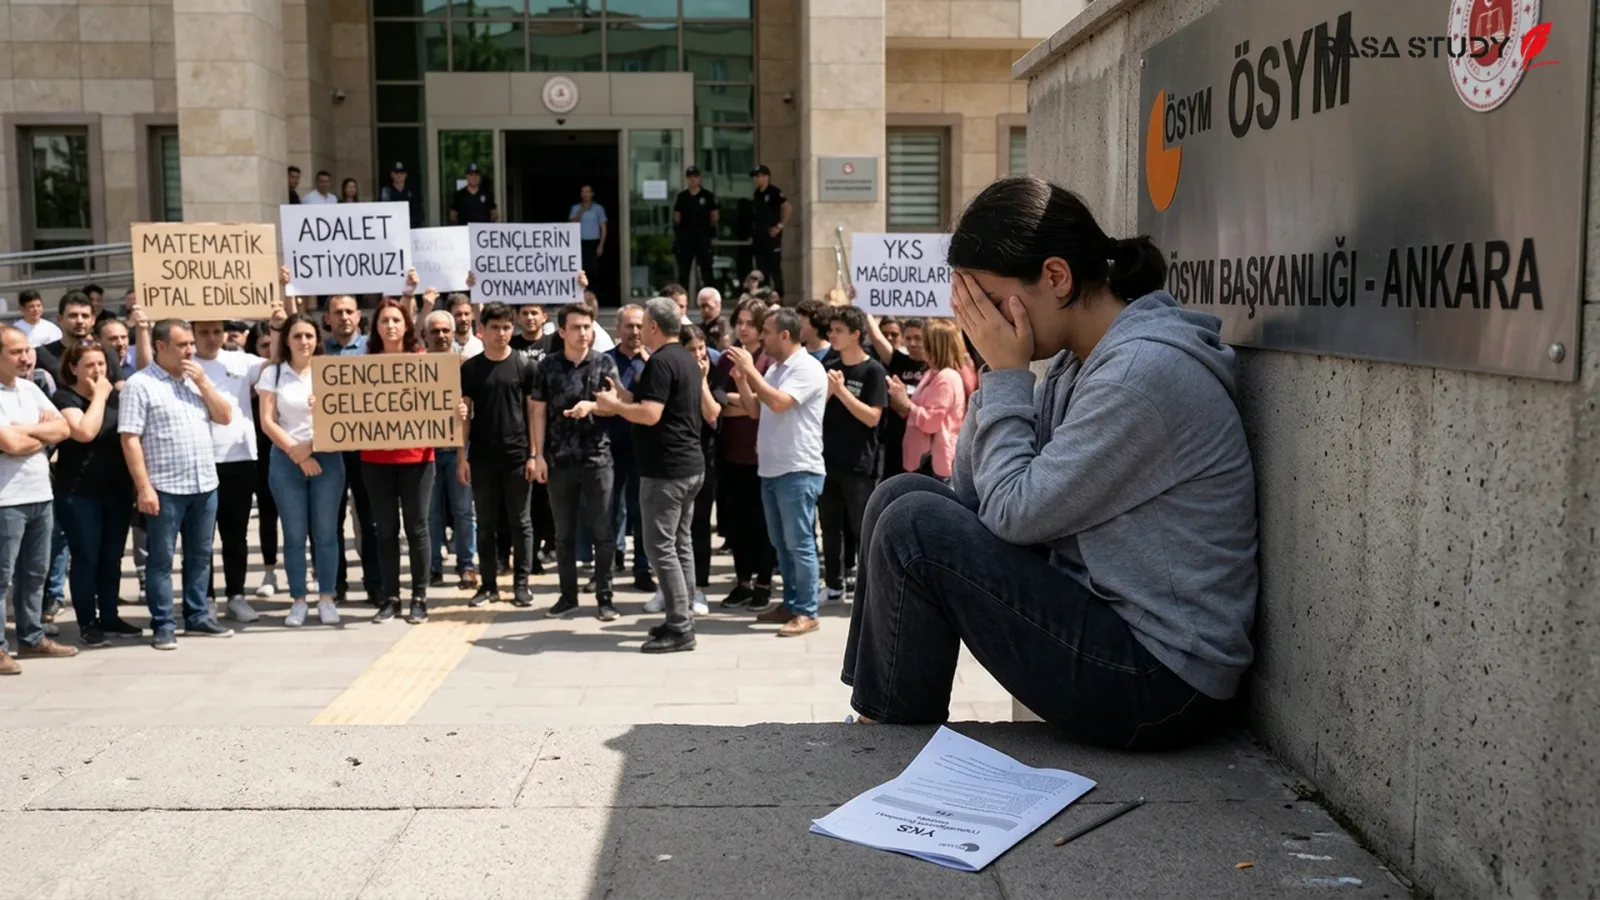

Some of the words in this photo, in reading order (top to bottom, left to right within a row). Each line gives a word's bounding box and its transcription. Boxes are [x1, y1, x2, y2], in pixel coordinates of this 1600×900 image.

[1228, 11, 1352, 139] ÖSYM
[1165, 86, 1212, 143] ÖSYM
[142, 230, 263, 254] MATEMATİK
[298, 215, 392, 242] ADALET
[476, 226, 571, 252] GENÇLERİN
[475, 252, 578, 273] GELECEĞİYLE
[883, 239, 924, 260] YKS
[161, 259, 251, 280] SORULARI
[292, 248, 405, 279] İSTİYORUZ!
[481, 276, 577, 299] OYNAMAYIN!
[1168, 251, 1215, 305] ÖSYM
[1219, 236, 1357, 319] BAŞKANLIĞI
[1381, 237, 1544, 311] ANKARA
[142, 282, 195, 307] İPTAL
[202, 281, 275, 308] EDİLSİN!
[870, 288, 938, 308] BURADA
[322, 359, 439, 387] GENÇLERİN
[322, 386, 454, 415] GELECEĞİYLE
[330, 415, 455, 443] OYNAMAYIN!
